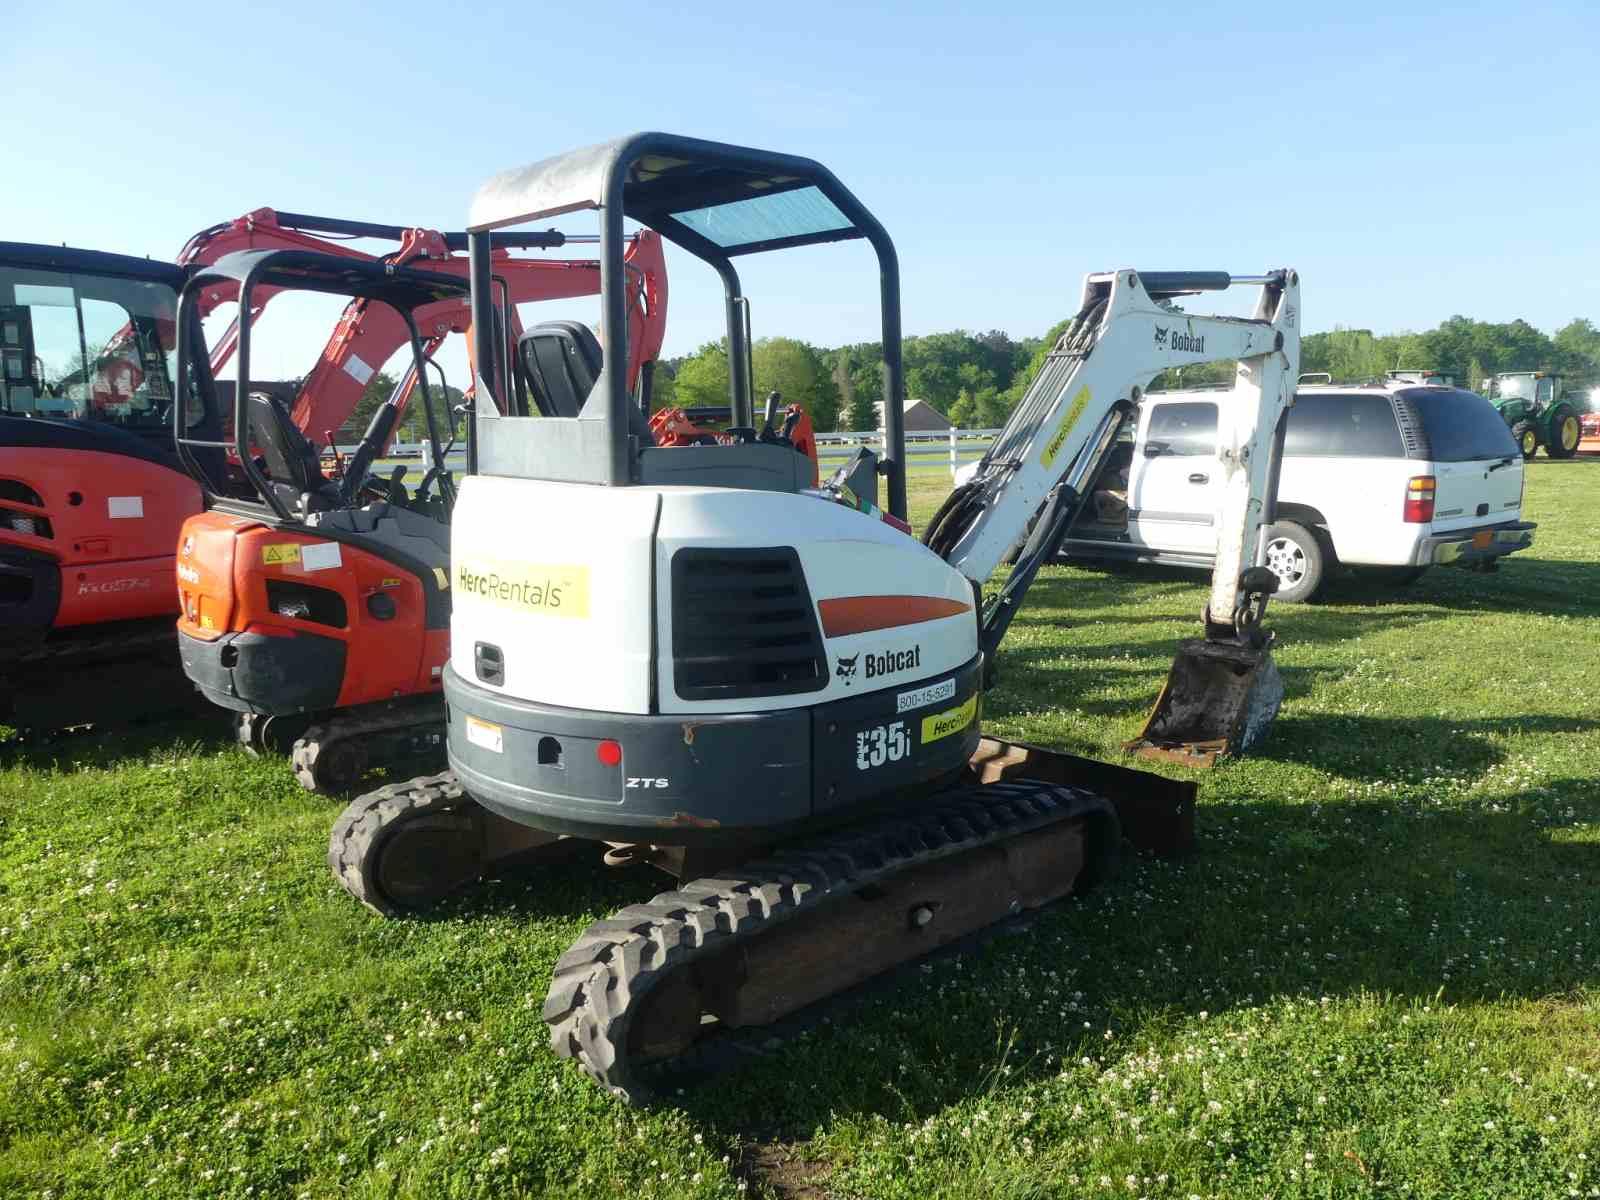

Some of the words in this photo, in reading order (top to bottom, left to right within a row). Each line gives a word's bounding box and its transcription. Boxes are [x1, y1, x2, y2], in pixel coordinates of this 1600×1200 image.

[1171, 331, 1205, 354] Bobcat
[460, 567, 562, 608] HercRentals
[865, 644, 921, 679] Bobcat
[856, 720, 911, 771] E35i
[626, 777, 670, 789] ZTS
